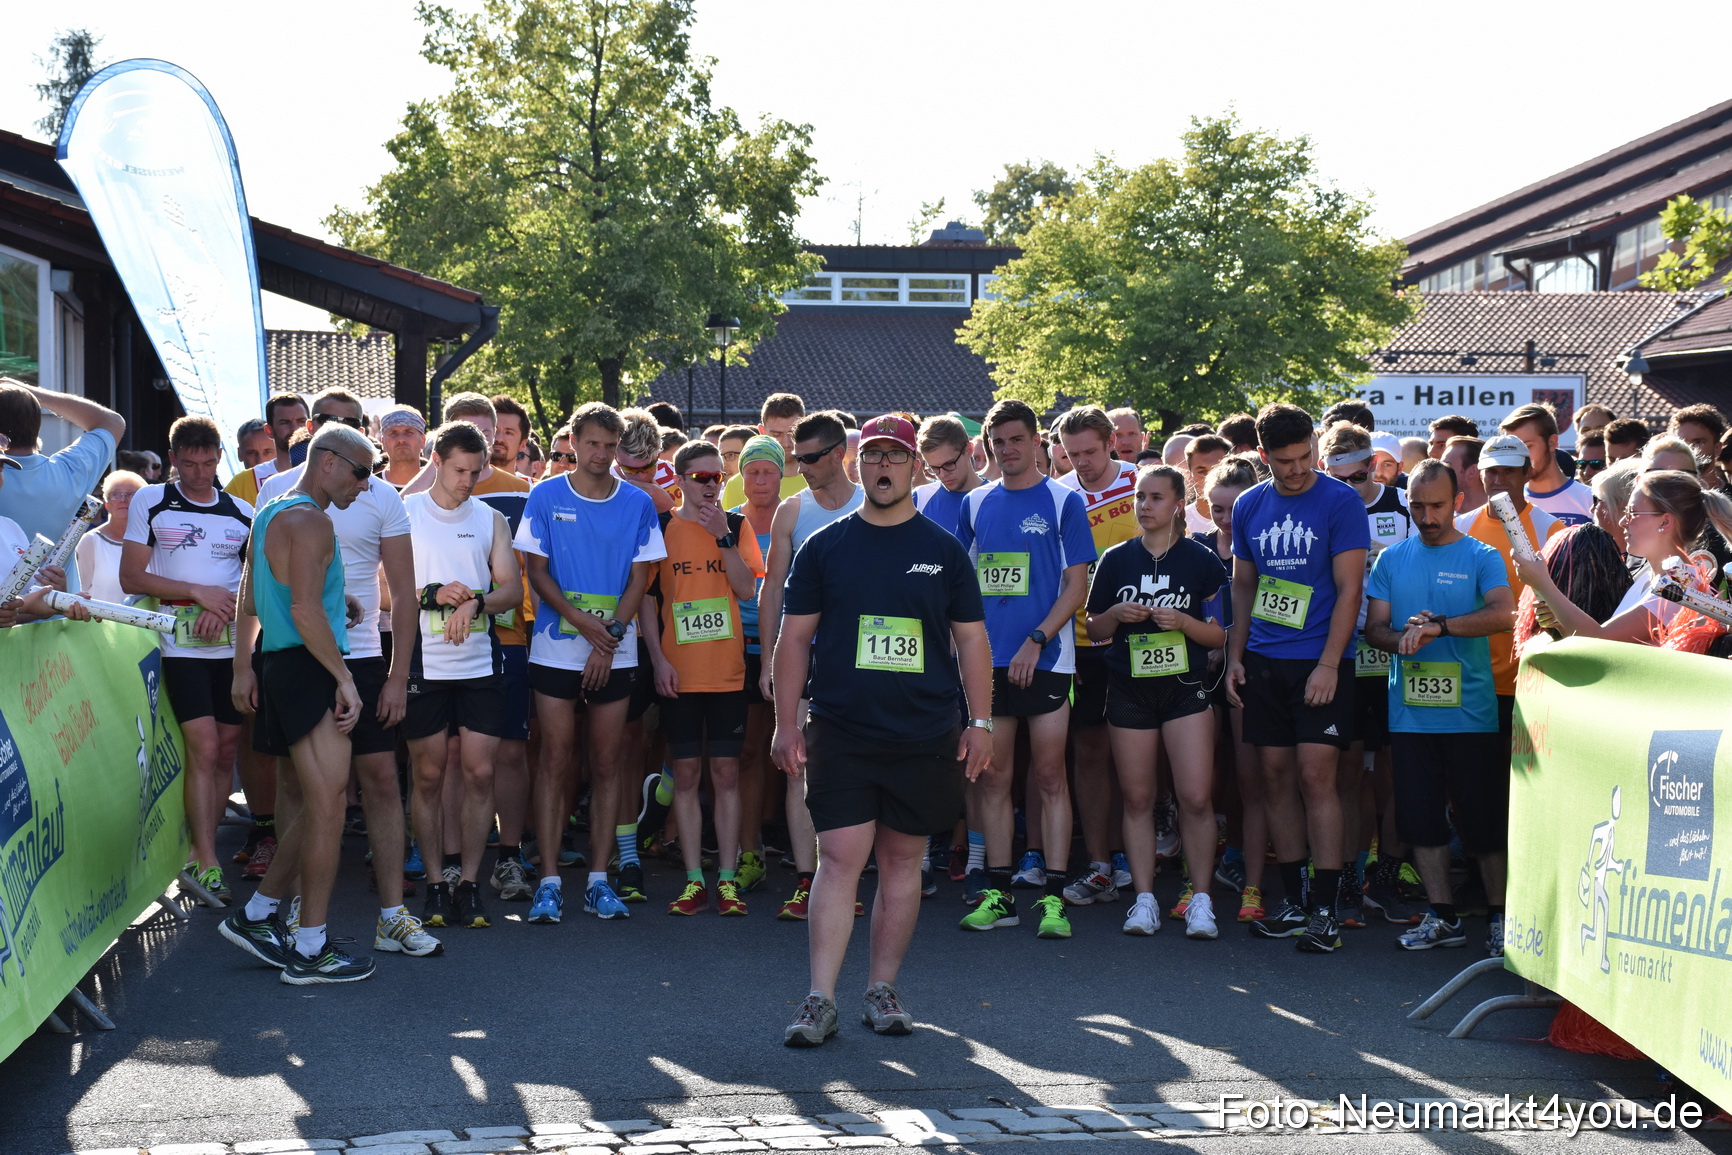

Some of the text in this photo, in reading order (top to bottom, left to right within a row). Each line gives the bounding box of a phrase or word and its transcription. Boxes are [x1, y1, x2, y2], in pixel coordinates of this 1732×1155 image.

[1414, 385, 1515, 406] Hallen
[1374, 417, 1400, 427] markt
[1108, 501, 1135, 519] BÖ
[673, 561, 692, 576] PE
[1266, 558, 1307, 567] GEMEINSAM
[983, 567, 1022, 584] 1975
[1261, 591, 1299, 615] 1351
[681, 613, 725, 632] 1488
[867, 634, 917, 657] 1138
[1141, 647, 1175, 665] 285
[1409, 677, 1453, 694] 1533
[1512, 705, 1552, 773] änger!
[1660, 774, 1704, 801] Fischer
[1664, 805, 1700, 816] AUTOMOBILE
[1619, 858, 1732, 956] firmenla
[1506, 914, 1545, 957] alz.de
[1618, 950, 1673, 983] neumarkt
